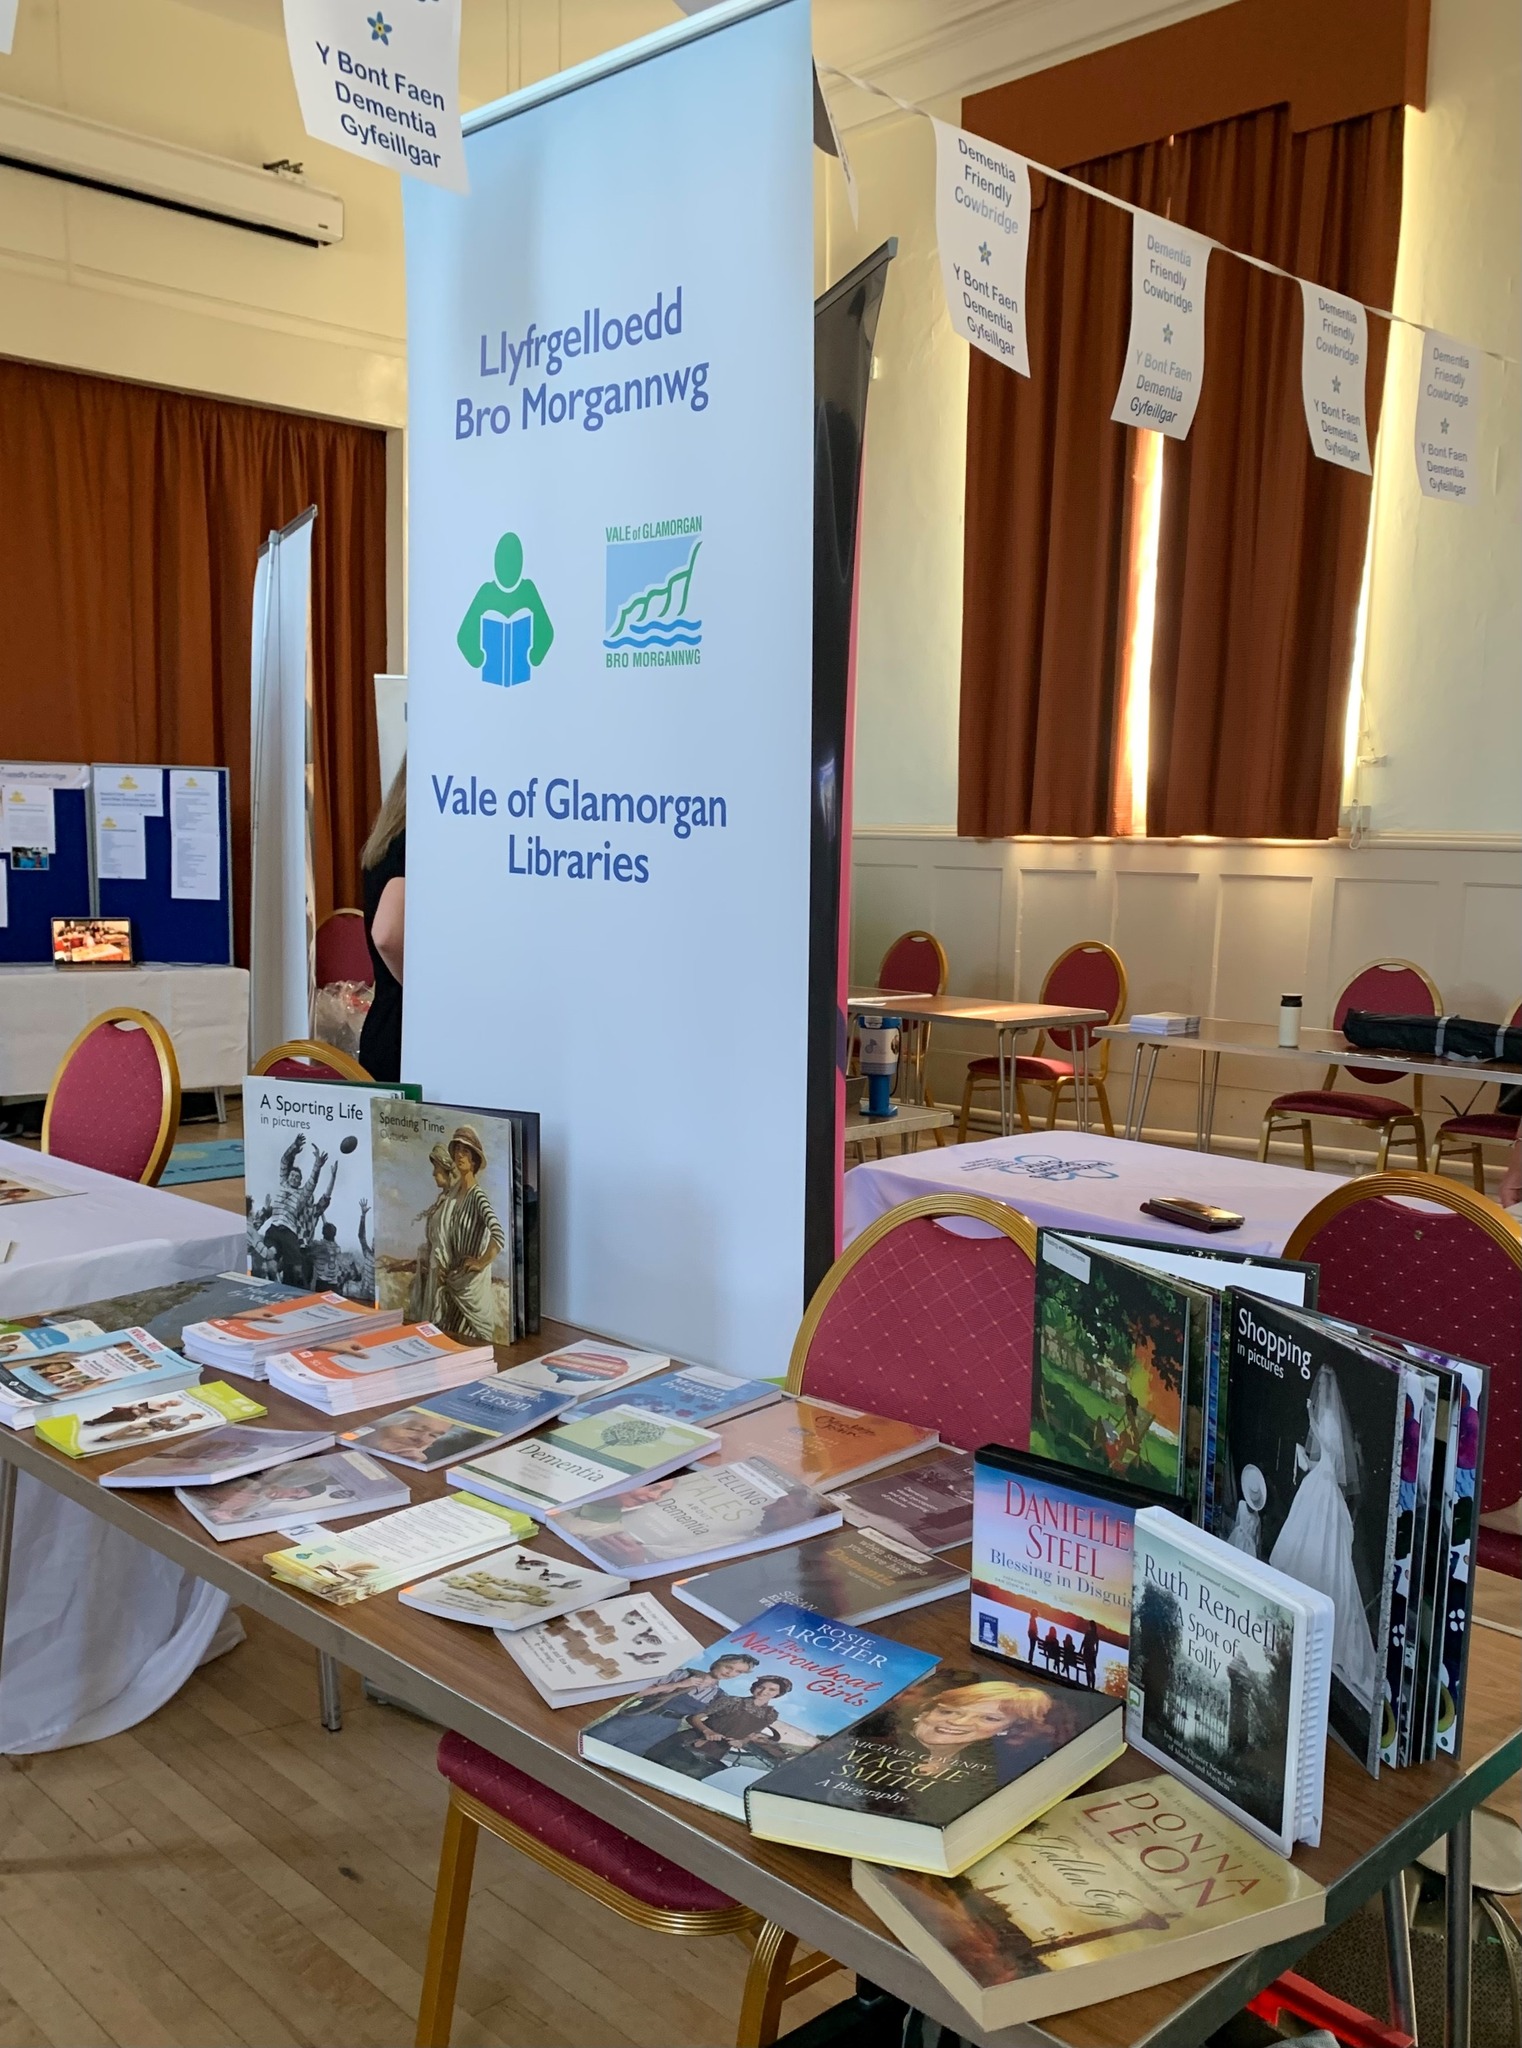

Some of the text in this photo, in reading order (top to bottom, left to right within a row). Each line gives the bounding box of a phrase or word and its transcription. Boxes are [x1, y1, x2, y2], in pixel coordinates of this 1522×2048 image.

[316, 41, 444, 111] Y Bont Faen
[335, 81, 437, 138] Dementia
[341, 114, 441, 168] Gyfeillgar
[958, 138, 1016, 183] Dementia
[964, 165, 1012, 207] Friendly
[954, 185, 1019, 234] Cowbridge
[1147, 234, 1192, 267] Dementia
[953, 263, 1018, 313] Y Bont Faen
[1149, 259, 1187, 291] Friendly
[963, 292, 1013, 334] Dementia
[1143, 279, 1193, 314] Cowbridge
[1318, 297, 1357, 324] Dementia
[480, 286, 682, 386] Llyfrgelloedd
[966, 315, 1015, 356] Gyfeillgar
[1322, 318, 1355, 345] Friendly
[1136, 350, 1192, 382] Y Bont Faen
[1316, 337, 1359, 366] Cowbridge
[1433, 348, 1470, 369] Dementia
[1136, 374, 1183, 402] Dementia
[1434, 368, 1465, 388] Friendly
[455, 362, 710, 440] Bro Morgannwg
[1130, 397, 1178, 424] Gyfeillgar
[1313, 399, 1361, 426] Y Bont Faen
[1426, 385, 1469, 408] Cowbridge
[1321, 420, 1358, 443] Dementia
[1427, 461, 1465, 479] Dementia
[1429, 443, 1446, 458] Bont
[1448, 448, 1468, 462] Faen
[606, 515, 702, 542] VALE of GLAMORGAN
[606, 649, 700, 668] BRO MORGANNWG
[431, 775, 727, 839] Vale of Glamorgan
[509, 834, 649, 883] Libraries
[260, 1094, 363, 1121] A Sporting Life
[260, 1114, 311, 1130] in pictures
[379, 1112, 445, 1133] Spending Time
[1237, 1339, 1284, 1379] in pictures
[1238, 1308, 1312, 1380] Shopping
[469, 1388, 532, 1412] Person
[517, 1443, 605, 1483] Dementia
[680, 1475, 753, 1522] TALES
[712, 1470, 768, 1506] TELLING
[655, 1498, 710, 1536] Dementia
[687, 1503, 713, 1520] ABOUT
[1004, 1479, 1130, 1551] DANIELLE
[825, 1548, 897, 1587] Dementia
[842, 1543, 867, 1557] you
[865, 1551, 887, 1566] love
[886, 1563, 907, 1576] has
[859, 1540, 886, 1555] when
[884, 1553, 928, 1576] someone
[1026, 1524, 1105, 1581] STEEL
[990, 1548, 1133, 1608] Blessing in Disguis
[779, 1590, 819, 1612] SUSAN
[1145, 1553, 1276, 1652] Ruth Rendell
[776, 1624, 889, 1670] ARCHER
[778, 1639, 806, 1654] The
[816, 1623, 877, 1650] ROSIE
[1174, 1607, 1240, 1658] A Spot of
[729, 1631, 884, 1692] Narrowboat
[1188, 1639, 1221, 1678] Folly
[806, 1679, 869, 1708] Girls
[837, 1750, 971, 1783] MAGGIE
[850, 1739, 993, 1772] MICHAEL COVENEY
[815, 1779, 910, 1804] A Biography
[831, 1764, 937, 1793] SMITH
[1209, 1762, 1221, 1776] New
[1222, 1771, 1237, 1787] Tales
[1082, 1801, 1236, 1909] LEON
[1124, 1792, 1261, 1895] DONNA
[1007, 1835, 1106, 1886] Golden
[1068, 1889, 1145, 1920] Egg
